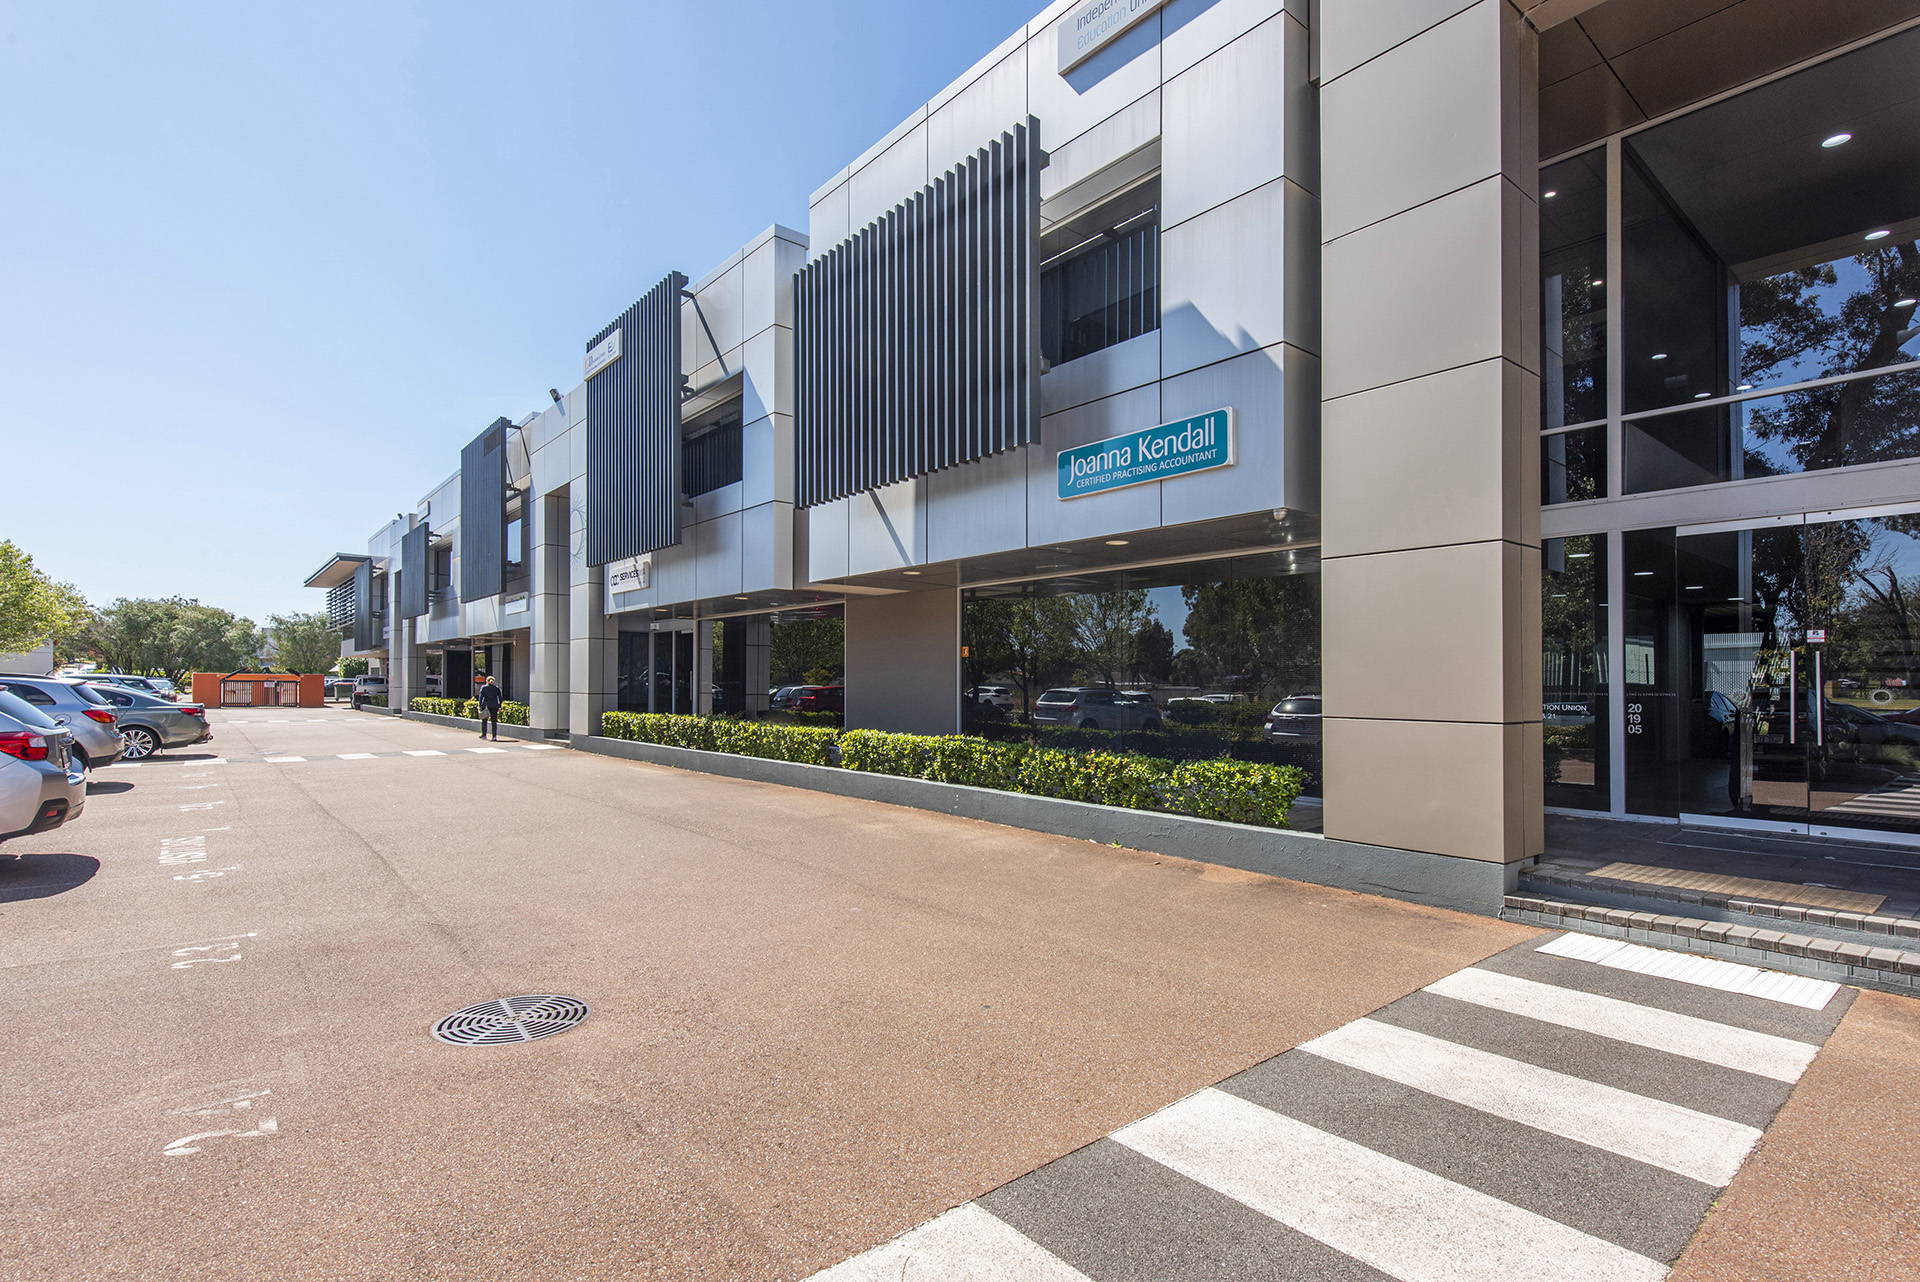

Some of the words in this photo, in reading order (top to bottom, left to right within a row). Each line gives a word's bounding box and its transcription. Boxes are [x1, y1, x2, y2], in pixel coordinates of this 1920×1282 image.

[1077, 6, 1127, 50] education
[1067, 446, 1131, 486] Joanna
[1138, 416, 1215, 462] Kendall
[1076, 473, 1111, 488] CERTIFIED
[1112, 462, 1158, 480] PRACTISING
[1159, 448, 1217, 470] ACCOUNTANT
[619, 569, 639, 581] SERVICES
[1627, 703, 1642, 713] 20
[1627, 714, 1641, 724] 19
[1627, 725, 1642, 734] 05
